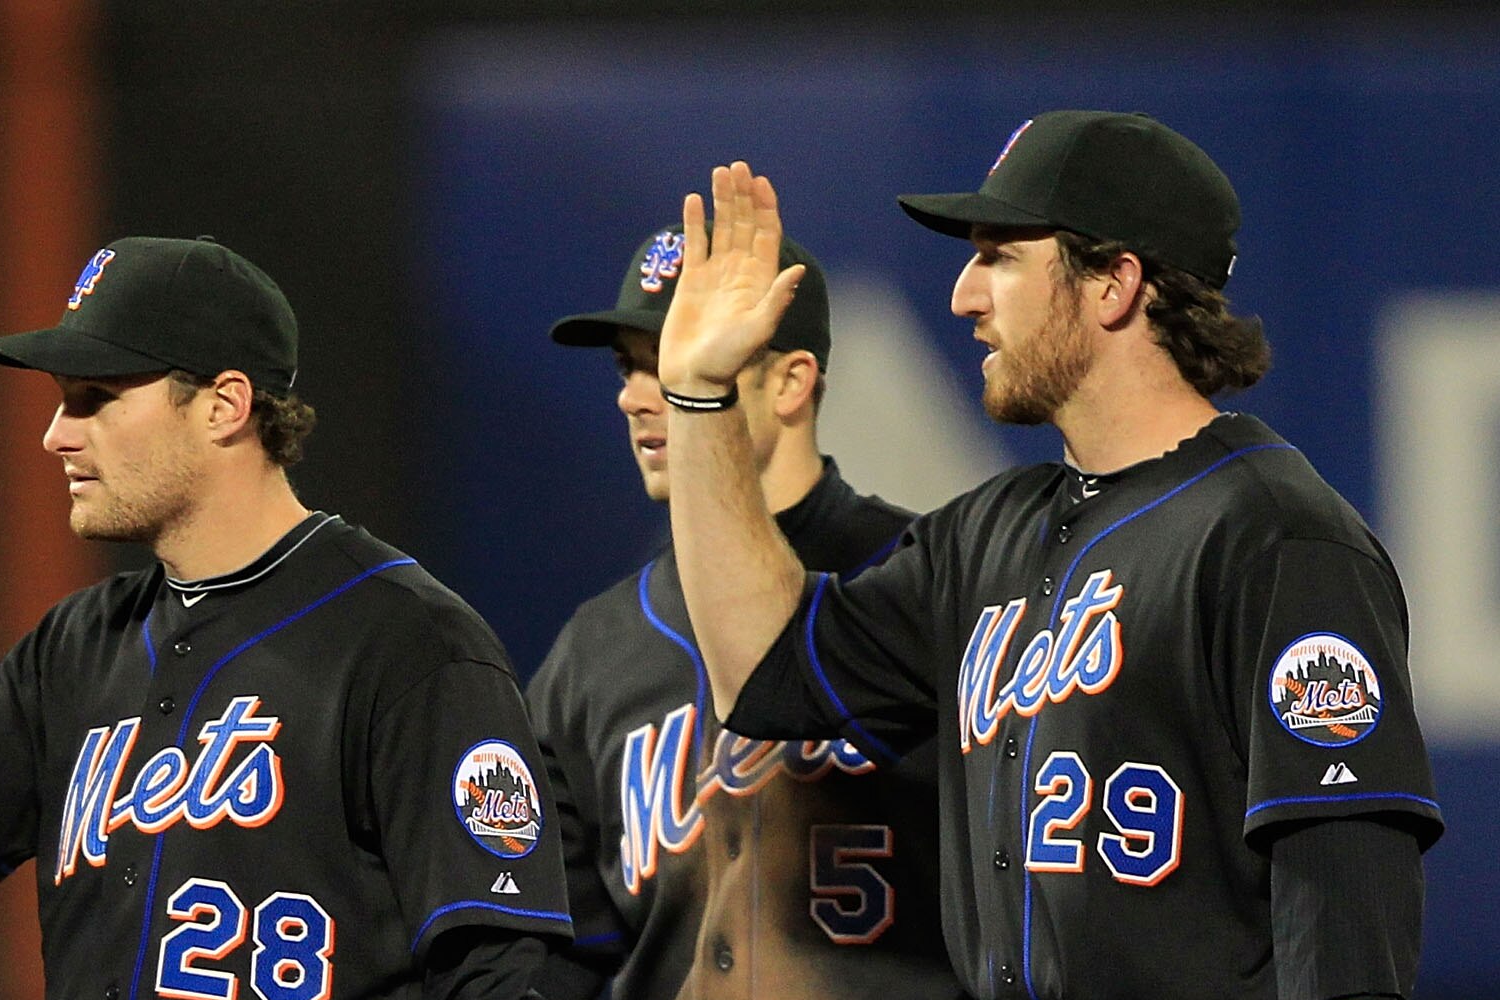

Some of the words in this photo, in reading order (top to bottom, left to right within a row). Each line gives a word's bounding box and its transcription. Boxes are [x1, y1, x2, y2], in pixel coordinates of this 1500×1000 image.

[956, 568, 1124, 754] Mets
[1290, 678, 1365, 716] Mets
[53, 694, 286, 887] Mets
[471, 788, 531, 824] Mets
[1025, 750, 1186, 887] 29
[809, 823, 895, 945] 5
